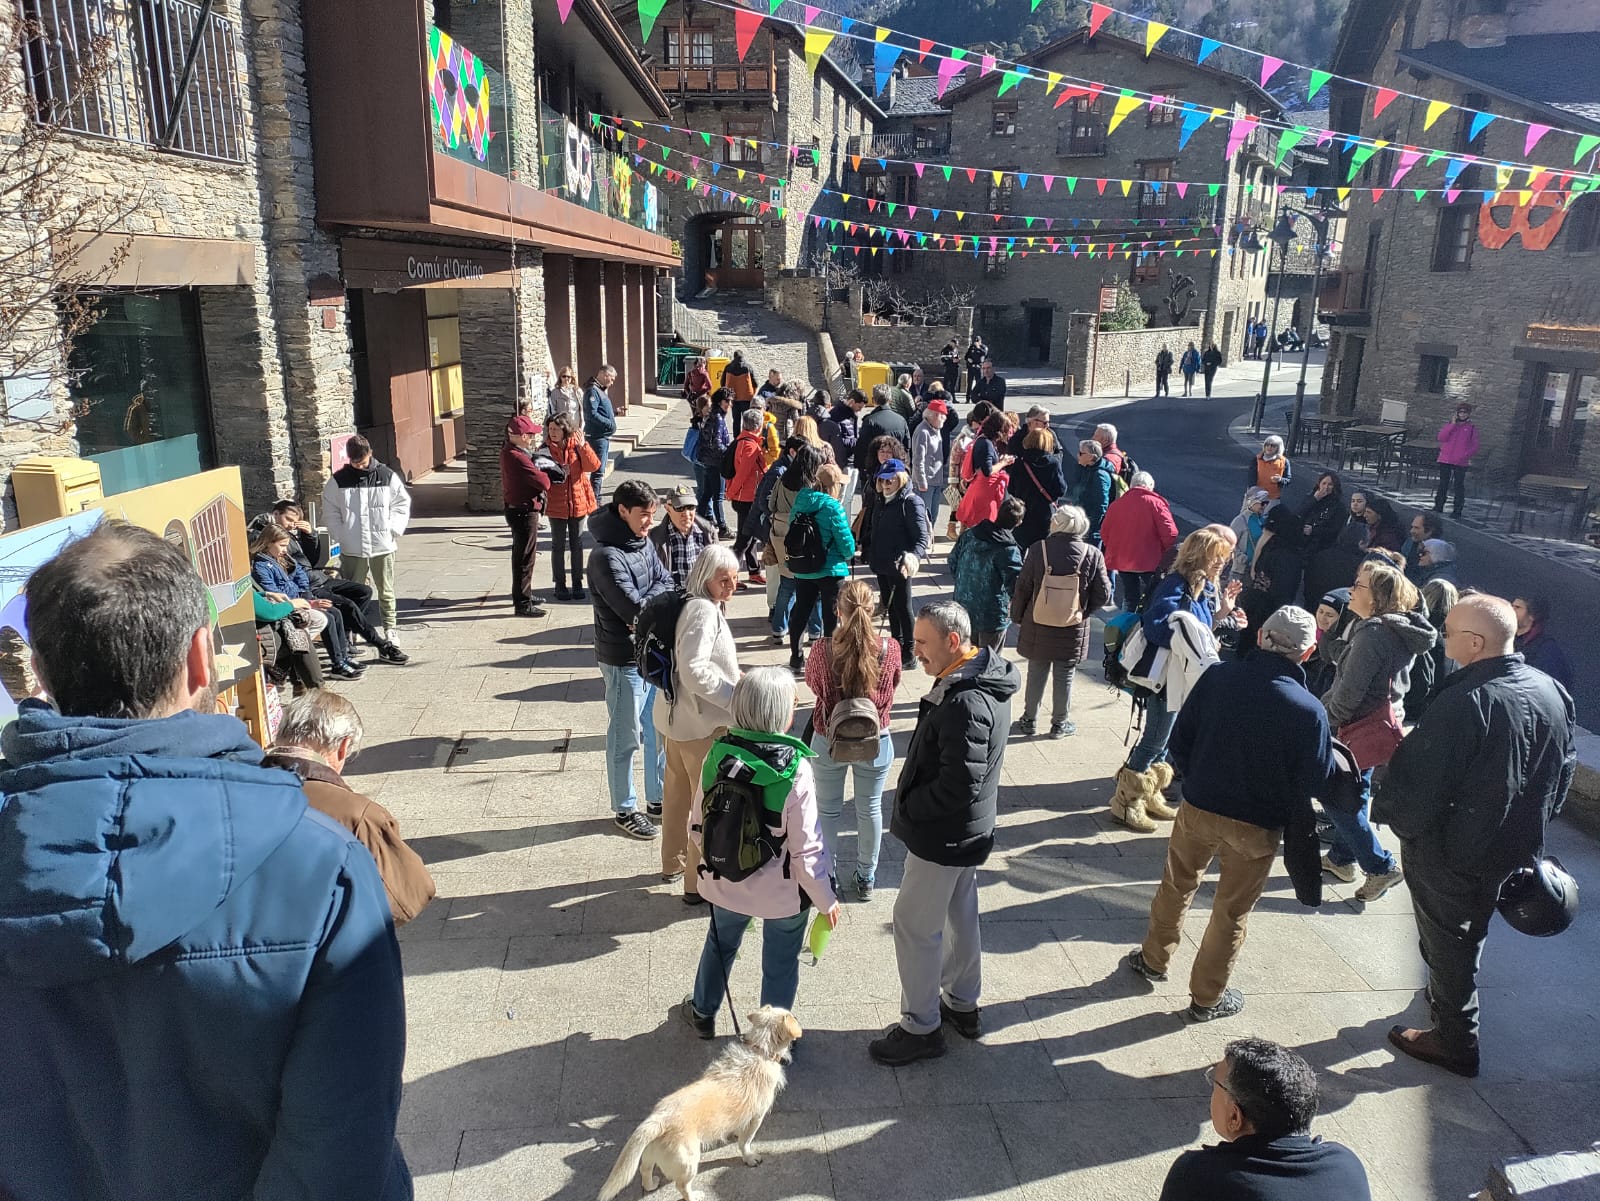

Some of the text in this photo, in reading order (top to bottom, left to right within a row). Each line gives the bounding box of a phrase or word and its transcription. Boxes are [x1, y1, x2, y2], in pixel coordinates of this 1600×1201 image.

[772, 189, 781, 201] H
[407, 255, 484, 281] Comú d'Ordino
